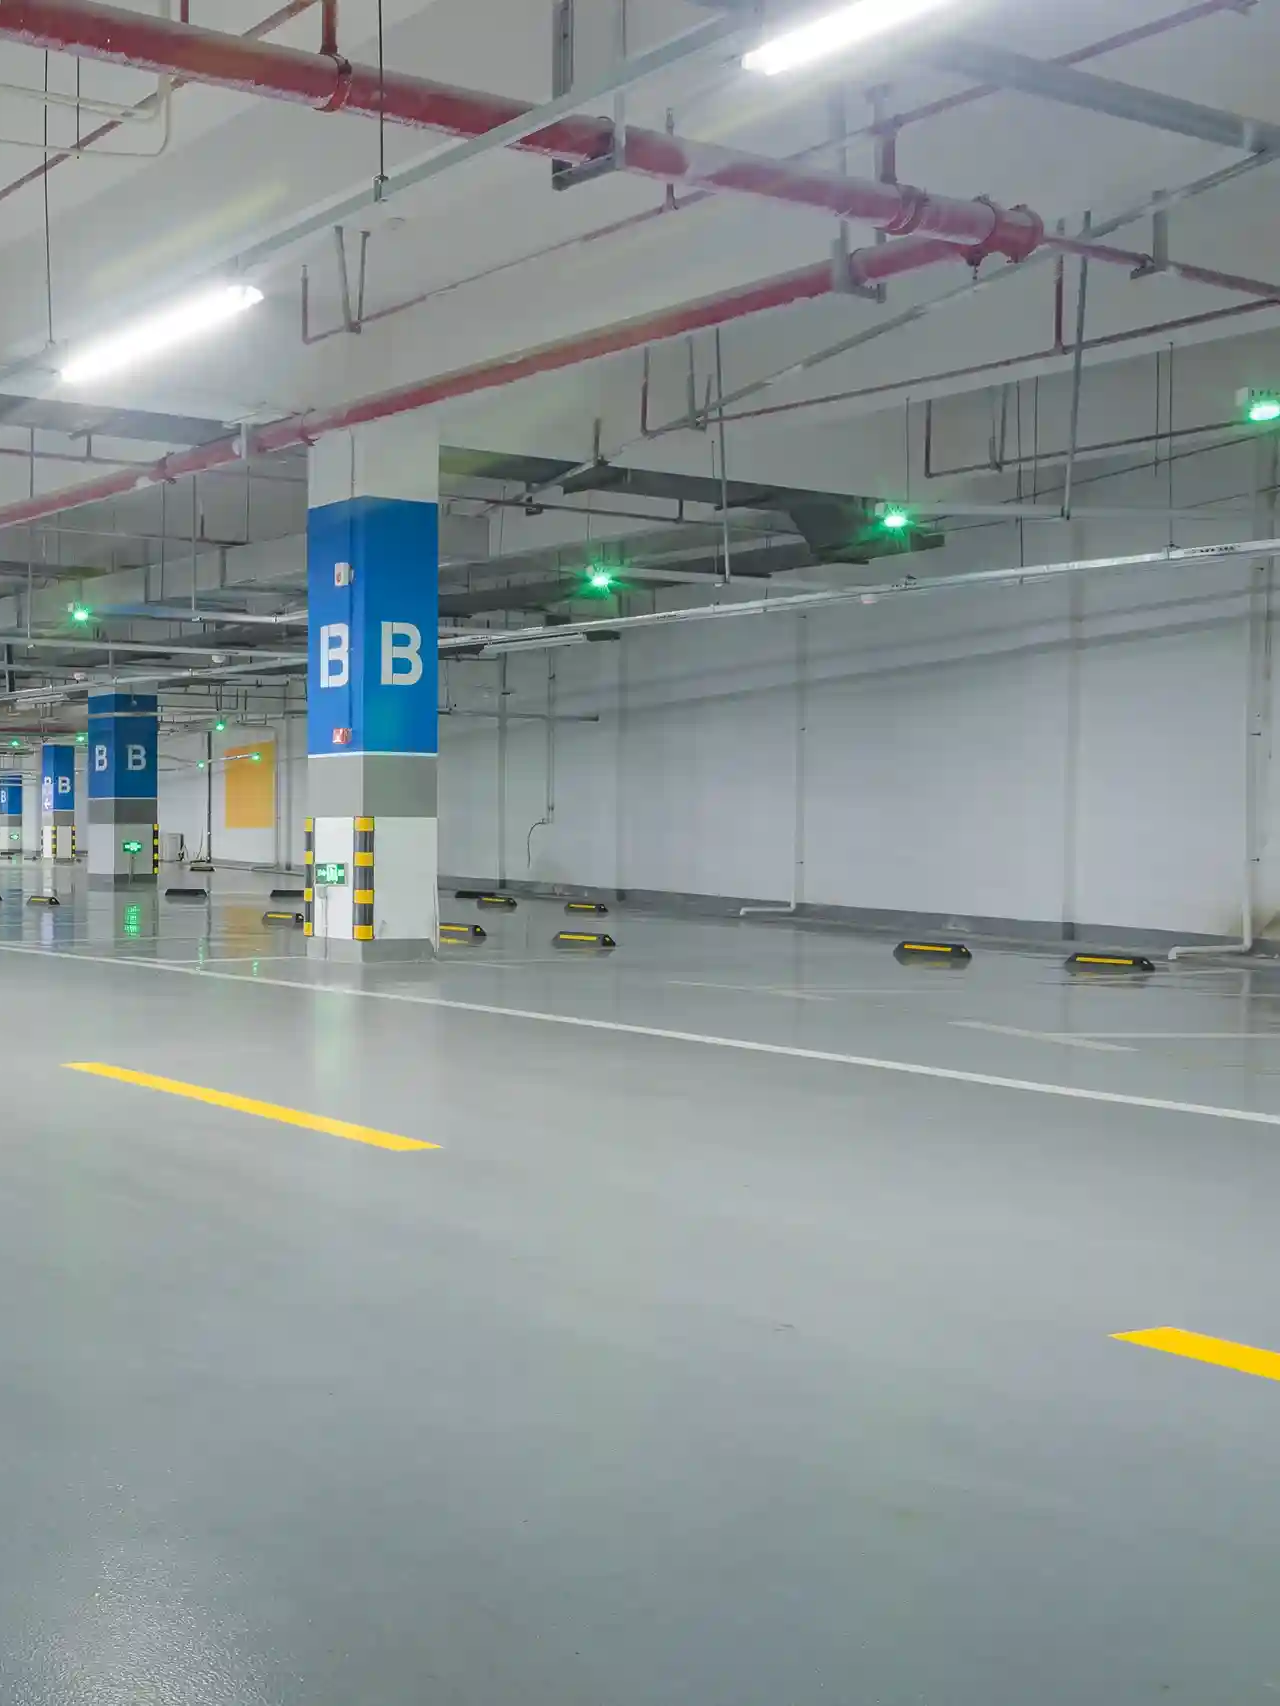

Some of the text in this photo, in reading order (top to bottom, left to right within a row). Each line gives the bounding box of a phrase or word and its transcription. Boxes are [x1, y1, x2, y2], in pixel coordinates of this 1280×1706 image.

[320, 623, 349, 688] B
[381, 621, 423, 686] B
[95, 745, 107, 771] B
[127, 744, 146, 770] B
[58, 776, 71, 793] B
